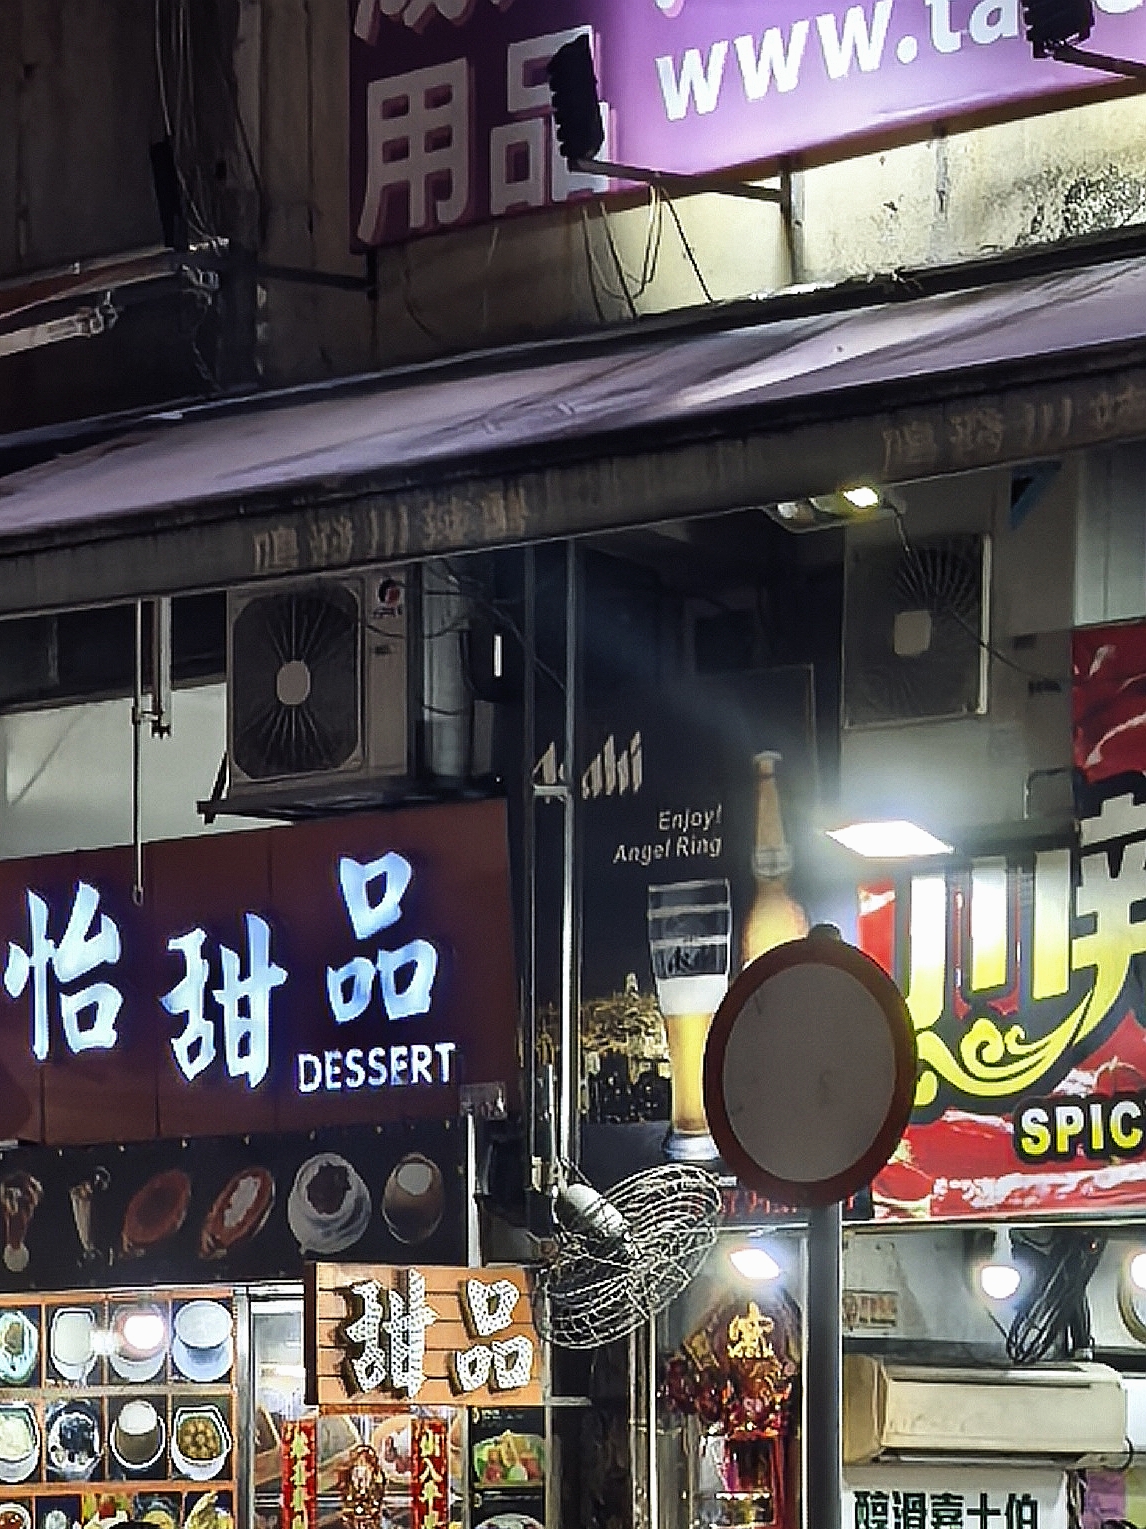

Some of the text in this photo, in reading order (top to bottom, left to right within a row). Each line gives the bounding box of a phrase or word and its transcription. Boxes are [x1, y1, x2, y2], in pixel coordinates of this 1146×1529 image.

[357, 24, 609, 243] 用品
[533, 731, 642, 800] Aahi
[658, 804, 721, 833] Enjoy!
[613, 834, 722, 866] Angel Ring
[297, 1041, 456, 1094] DESSERT
[1020, 1101, 1146, 1156] SPIC
[344, 1267, 534, 1399] 甜品
